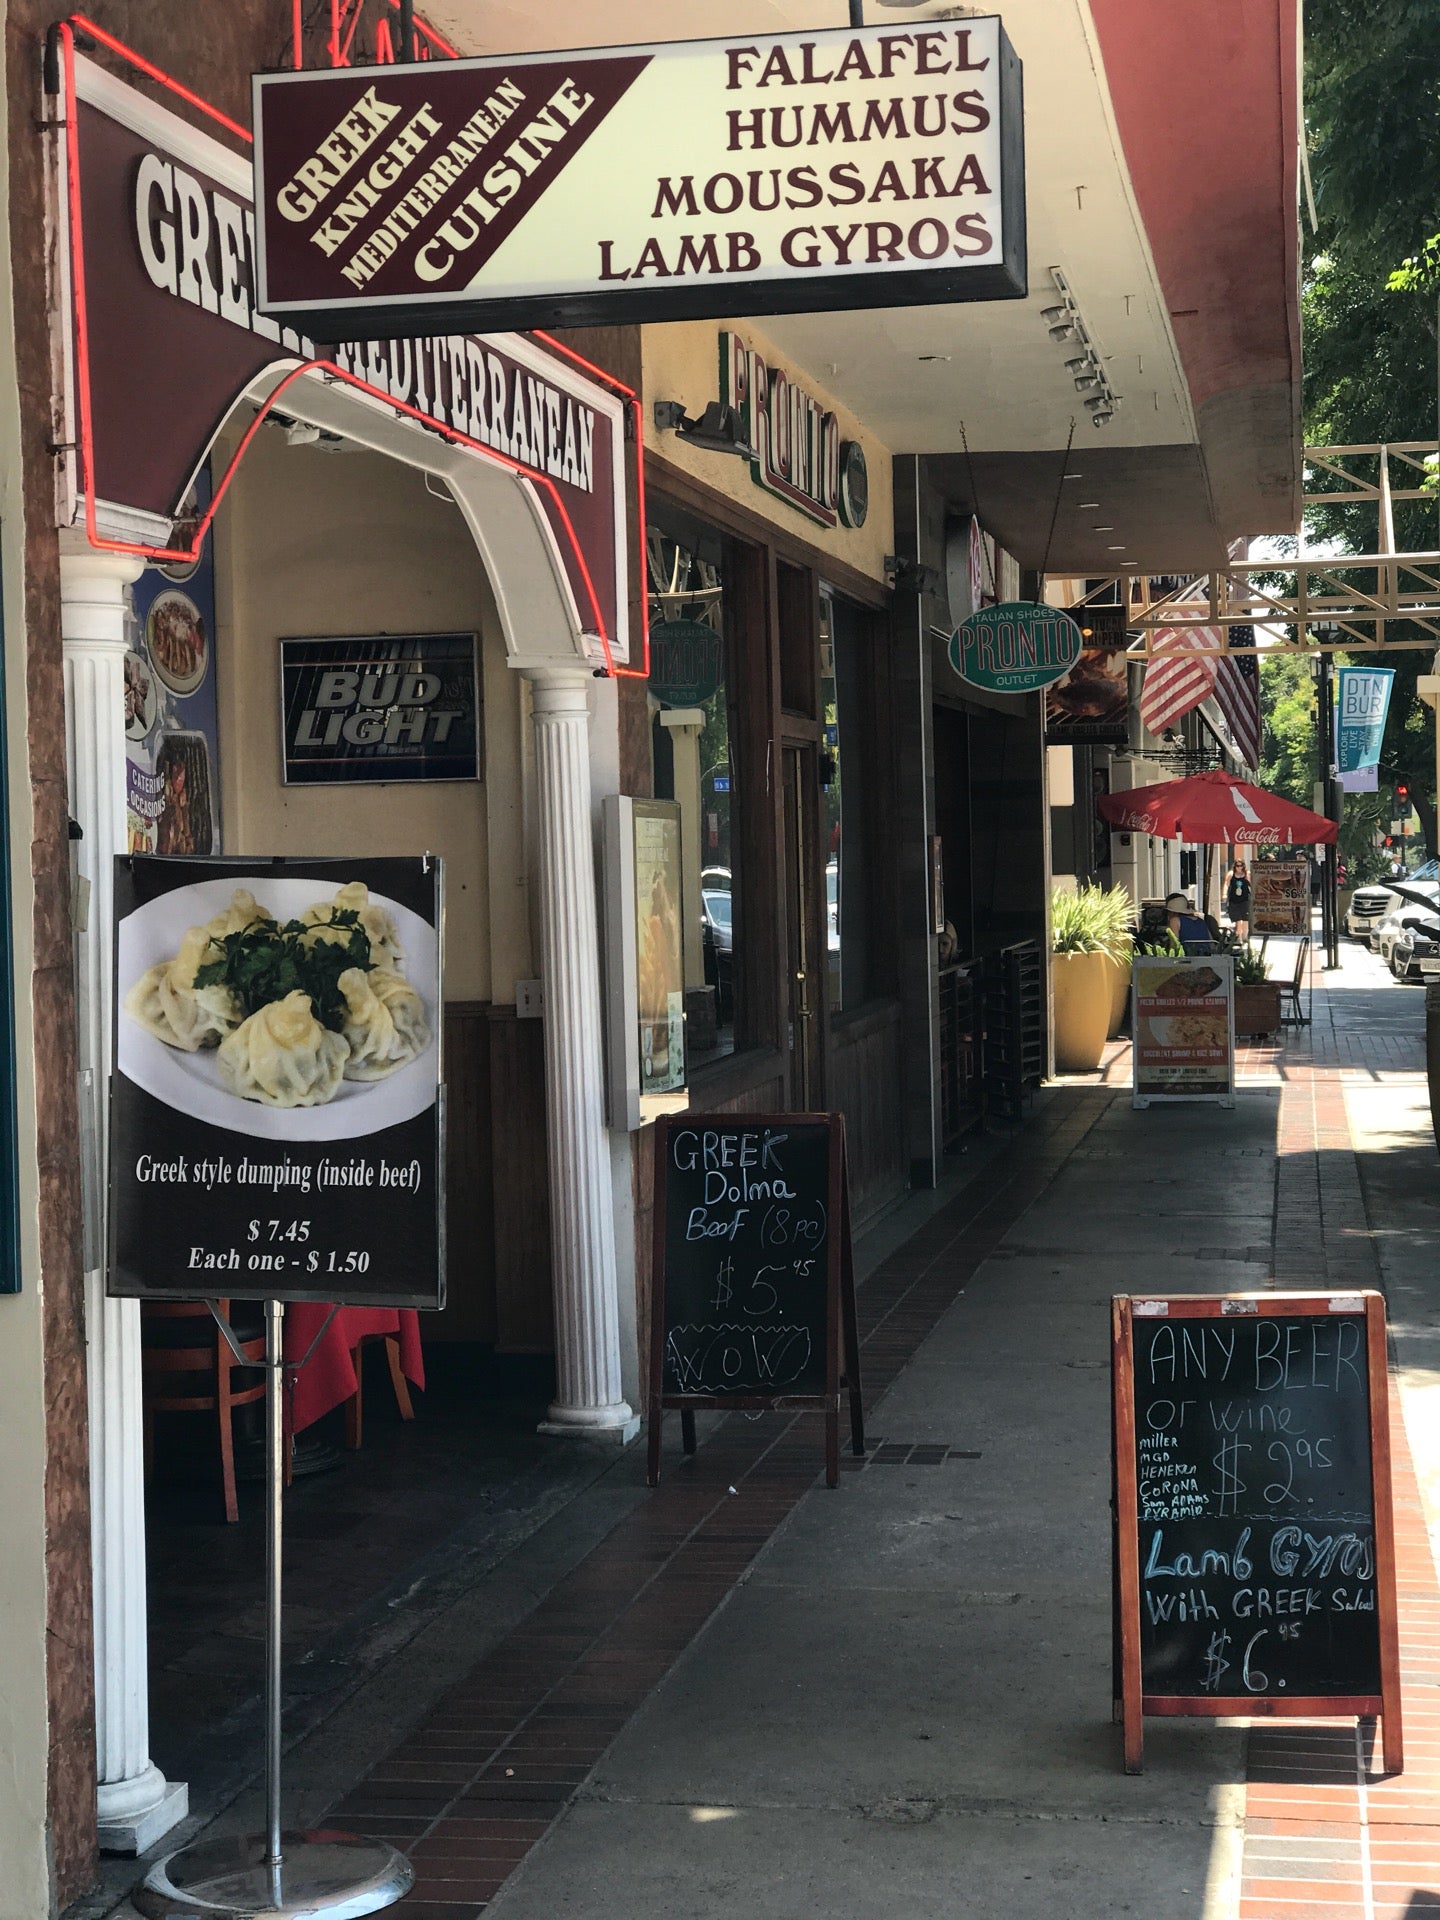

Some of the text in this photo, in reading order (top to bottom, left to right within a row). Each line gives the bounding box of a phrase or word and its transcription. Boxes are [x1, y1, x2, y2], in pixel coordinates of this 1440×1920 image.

[725, 30, 990, 90] FALAFEL
[726, 89, 991, 151] HUMMUS
[276, 84, 402, 222] GREEK
[309, 102, 443, 258] KNIGHT
[340, 76, 526, 291] MEDITERRANEAN
[414, 76, 595, 282] CUISINE
[651, 153, 992, 218] MOUSSAKA
[136, 153, 315, 361] GRE
[597, 212, 993, 281] LAMB GYROS
[719, 331, 840, 529] PRONTO
[971, 608, 1056, 623] ITALIAN SHOES
[957, 616, 1074, 676] PRONTO
[315, 671, 442, 708] BUD
[996, 674, 1038, 686] OUTLET
[1348, 678, 1384, 696] DTN
[1347, 697, 1381, 714] BUR
[294, 709, 463, 746] LIGHT
[1340, 730, 1349, 767] EXPLORE
[1349, 730, 1358, 749] LIVE
[132, 768, 165, 794] CATERING
[130, 790, 166, 817] OCCASIONS
[1234, 826, 1281, 843] Coca-Cola
[674, 1128, 789, 1171] GREEK
[135, 1153, 421, 1194] Greek style dumping (inside beef)
[705, 1168, 797, 1204] Dolma
[187, 1247, 240, 1270] Each
[248, 1254, 285, 1271] one
[669, 1332, 802, 1383] WOW
[1150, 1321, 1363, 1392] ANY BEER
[1144, 1526, 1254, 1581] Lamb
[1232, 1587, 1322, 1619] GREEK
